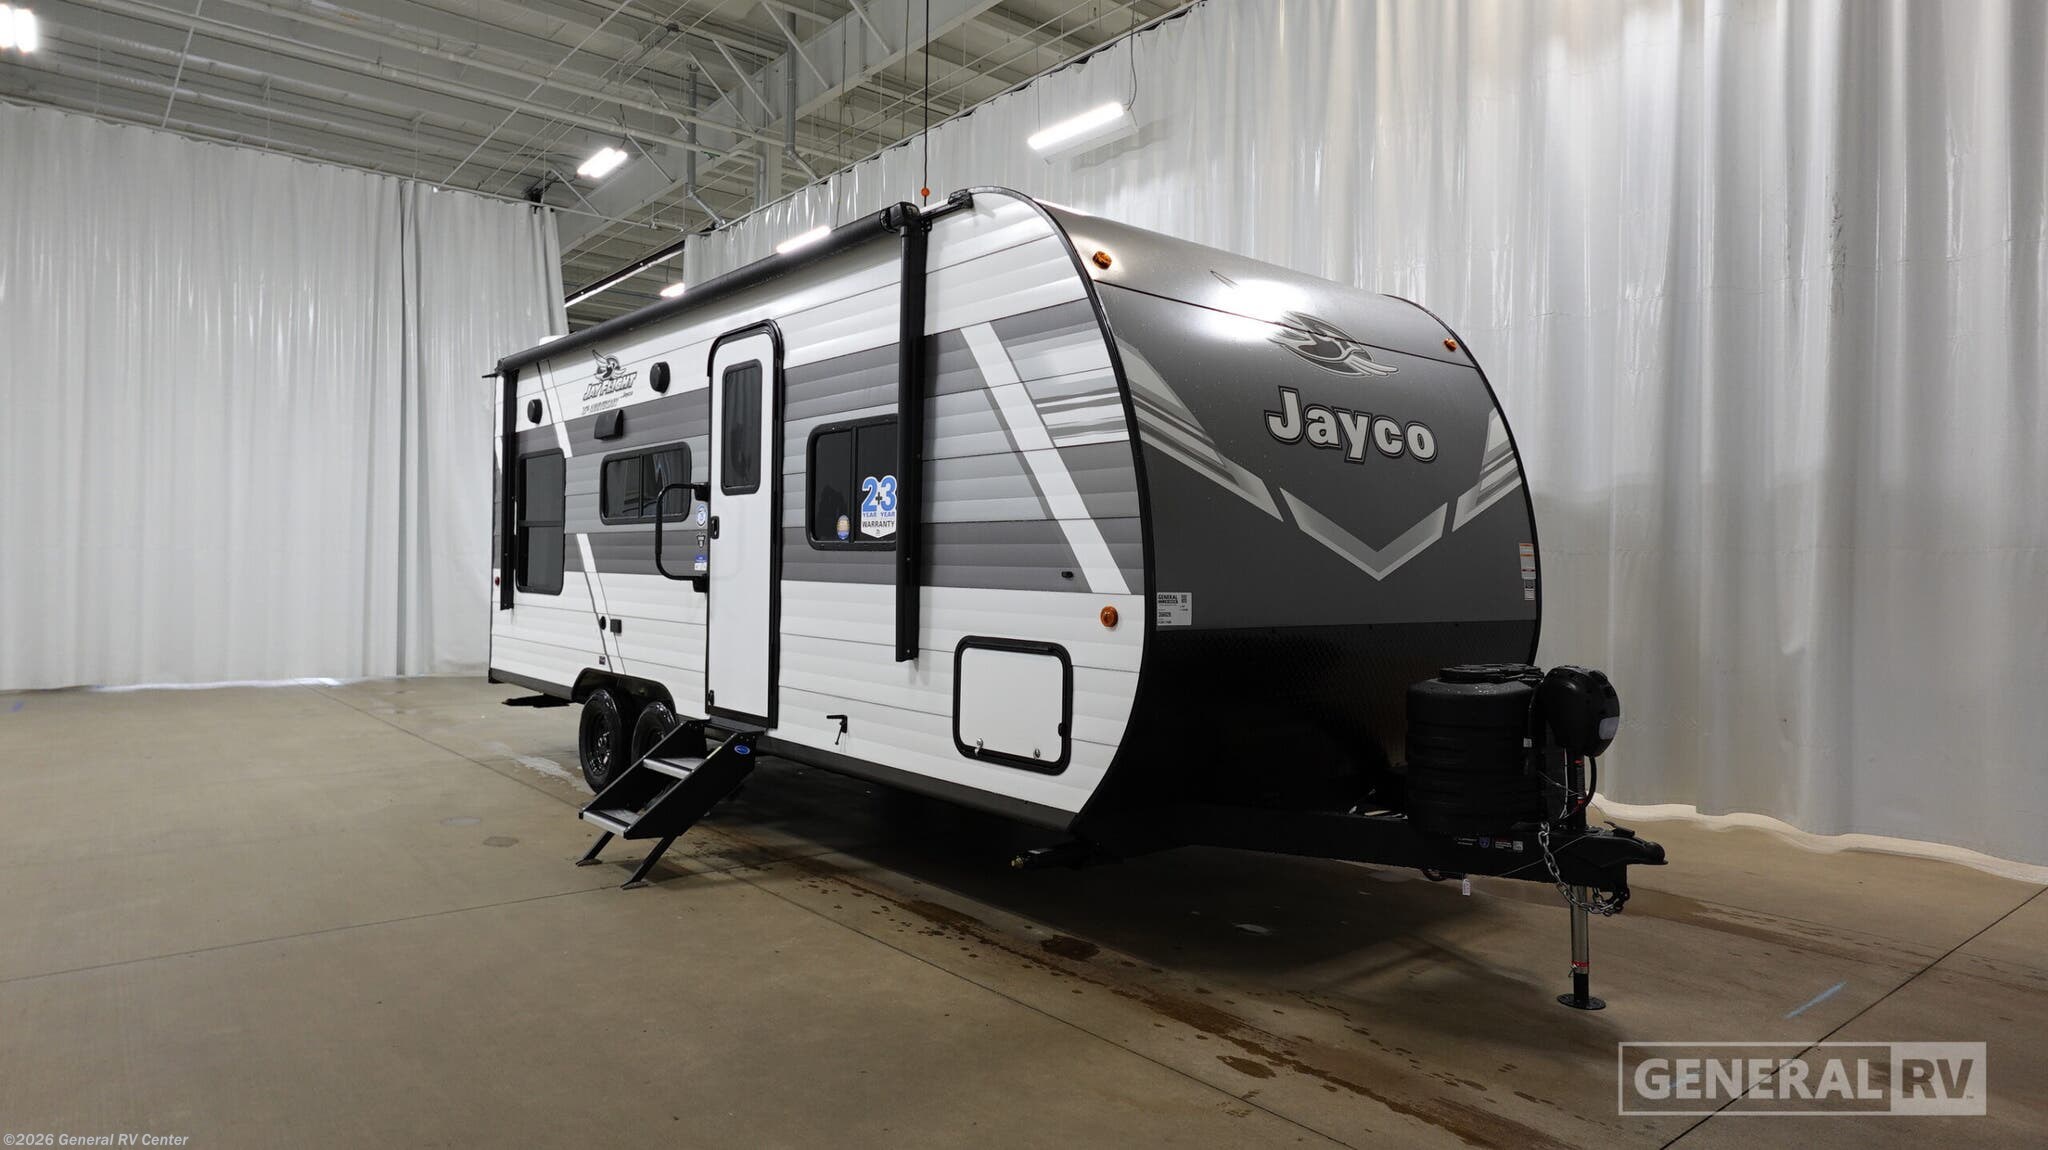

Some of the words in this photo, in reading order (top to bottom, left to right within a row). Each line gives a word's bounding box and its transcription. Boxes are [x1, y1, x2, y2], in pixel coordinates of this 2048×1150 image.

[583, 382, 604, 401] JAY
[600, 371, 637, 396] FLIGHT
[1264, 385, 1438, 465] Jayco
